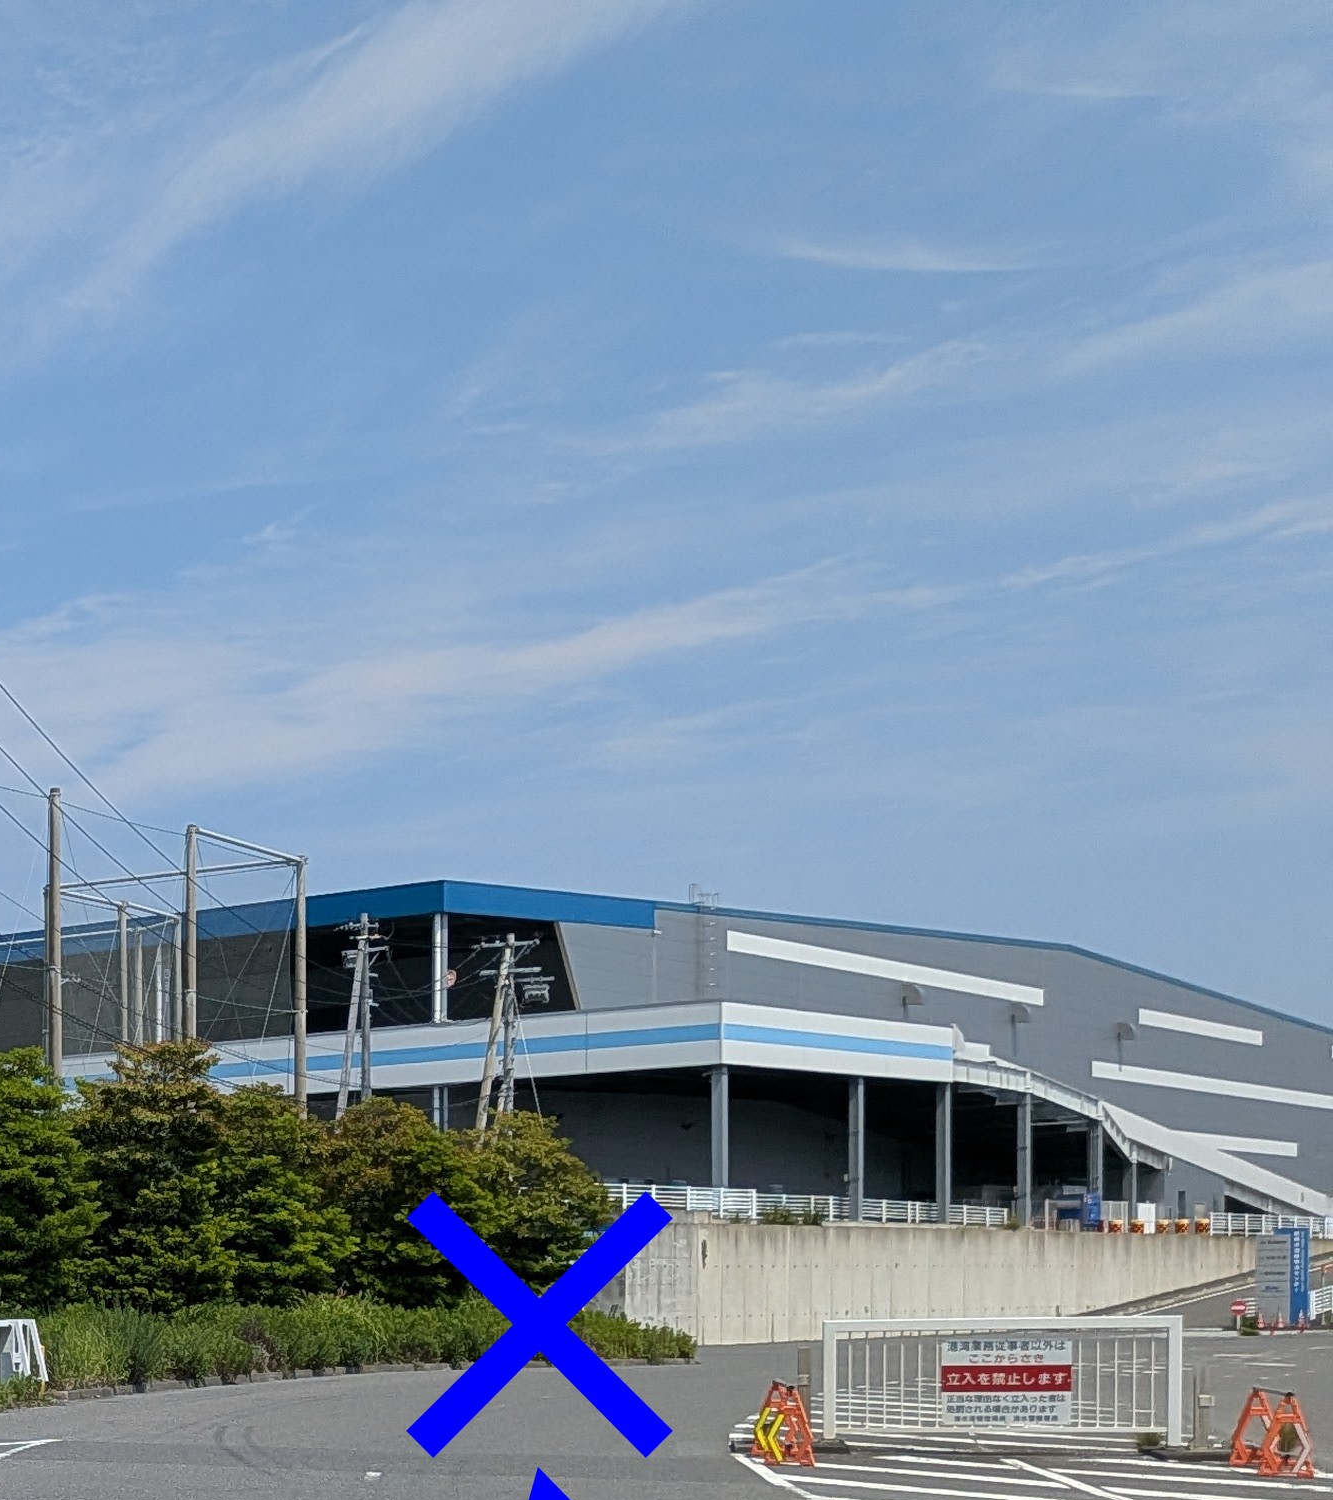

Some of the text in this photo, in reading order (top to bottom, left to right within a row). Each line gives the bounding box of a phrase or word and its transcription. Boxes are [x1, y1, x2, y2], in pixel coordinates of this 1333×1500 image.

[968, 1353, 1044, 1363] ここからさき
[945, 1372, 1068, 1385] 立入を禁止します
